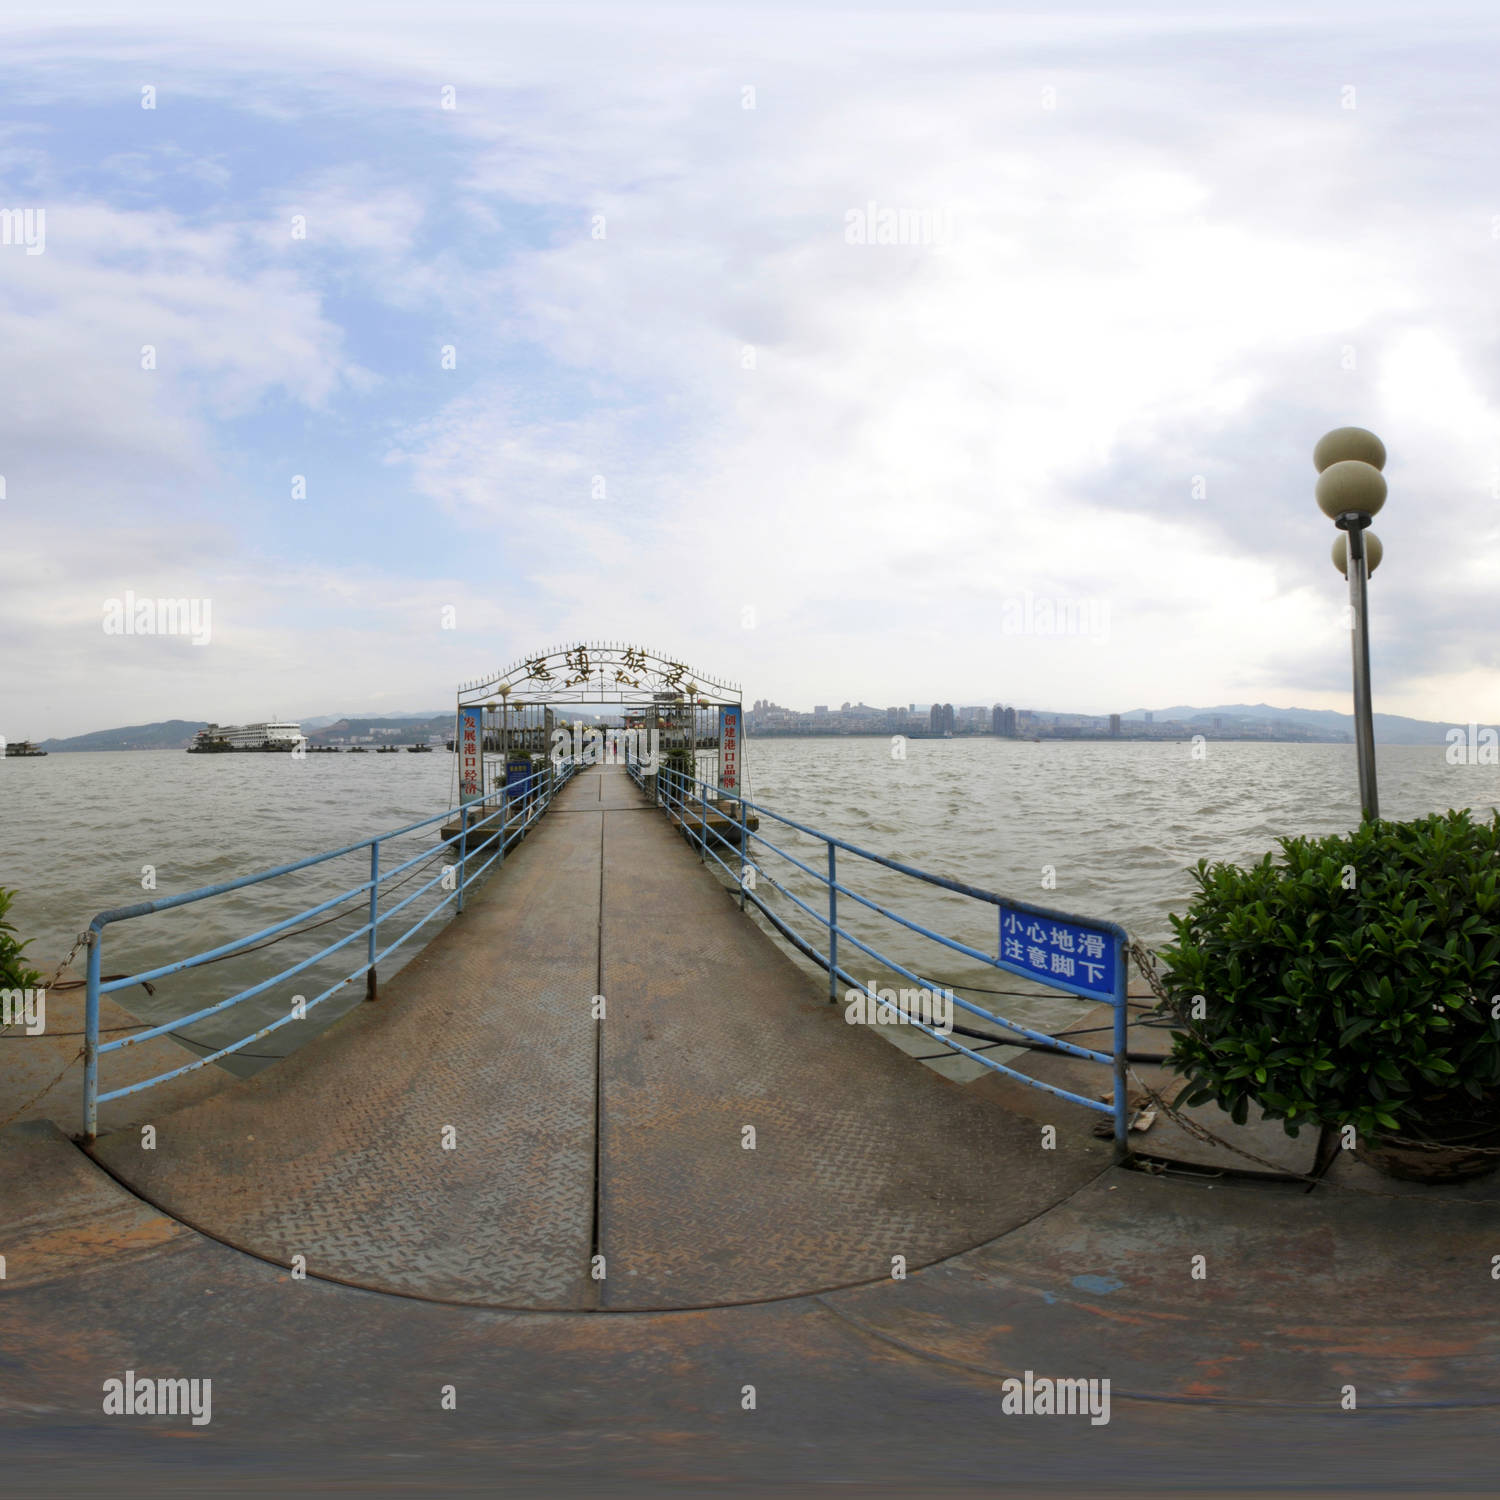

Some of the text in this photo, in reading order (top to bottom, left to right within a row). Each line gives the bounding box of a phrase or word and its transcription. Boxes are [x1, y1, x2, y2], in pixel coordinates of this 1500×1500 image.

[463, 716, 477, 795] 发展港口经济
[723, 714, 736, 788] 创建港口品牌
[1004, 914, 1106, 959] 小心地滑
[1004, 937, 1106, 984] 注意脚下
